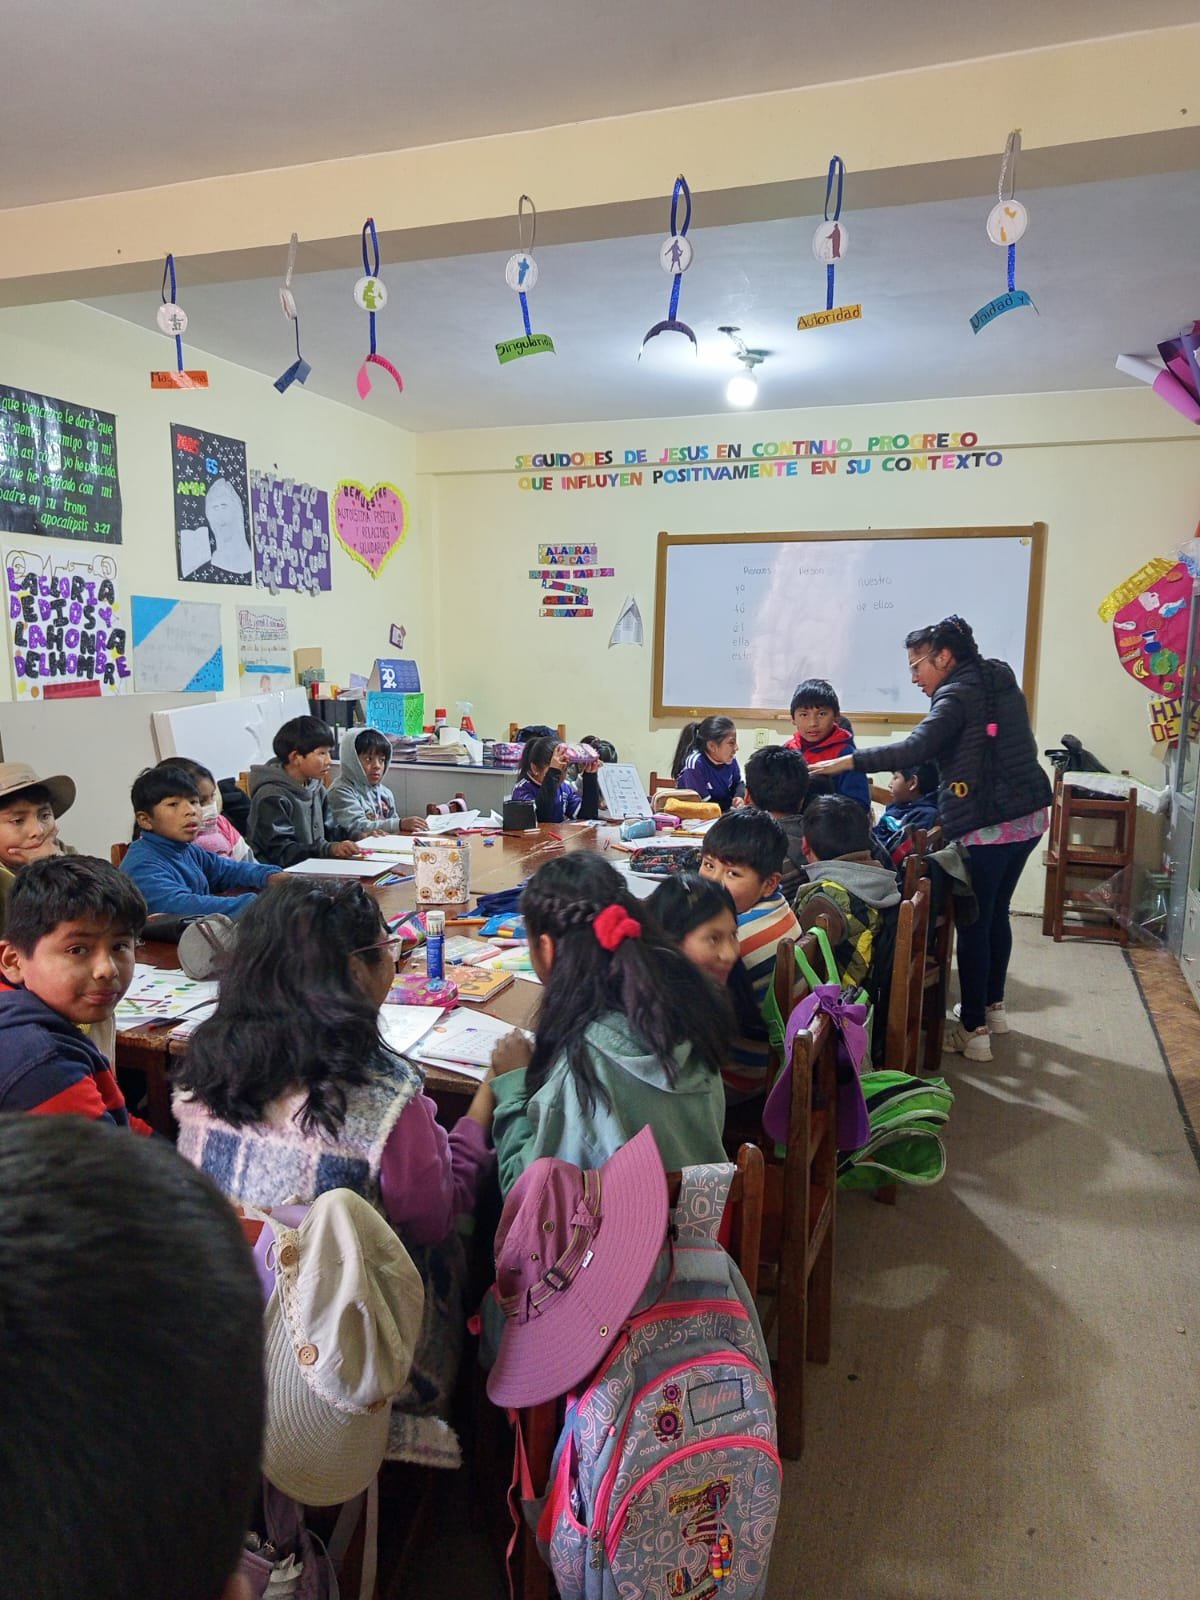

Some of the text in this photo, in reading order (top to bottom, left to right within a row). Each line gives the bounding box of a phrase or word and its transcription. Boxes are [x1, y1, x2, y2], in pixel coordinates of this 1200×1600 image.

[797, 303, 860, 329] Autoridad
[969, 292, 1013, 329] Unidad
[65, 408, 74, 425] le
[97, 422, 114, 436] que
[101, 442, 112, 456] mi
[514, 431, 978, 470] SEGUIDORES DE JESUS EN CONTINUO PROGRESO
[62, 455, 74, 471] yo
[518, 451, 1003, 491] QUE INFLUYEN POSITIVAMENTE EN SU CONTEXTO
[26, 467, 39, 484] he
[79, 482, 94, 496] con
[101, 485, 113, 498] mi
[45, 497, 57, 510] su
[40, 513, 89, 533] apocalipsis
